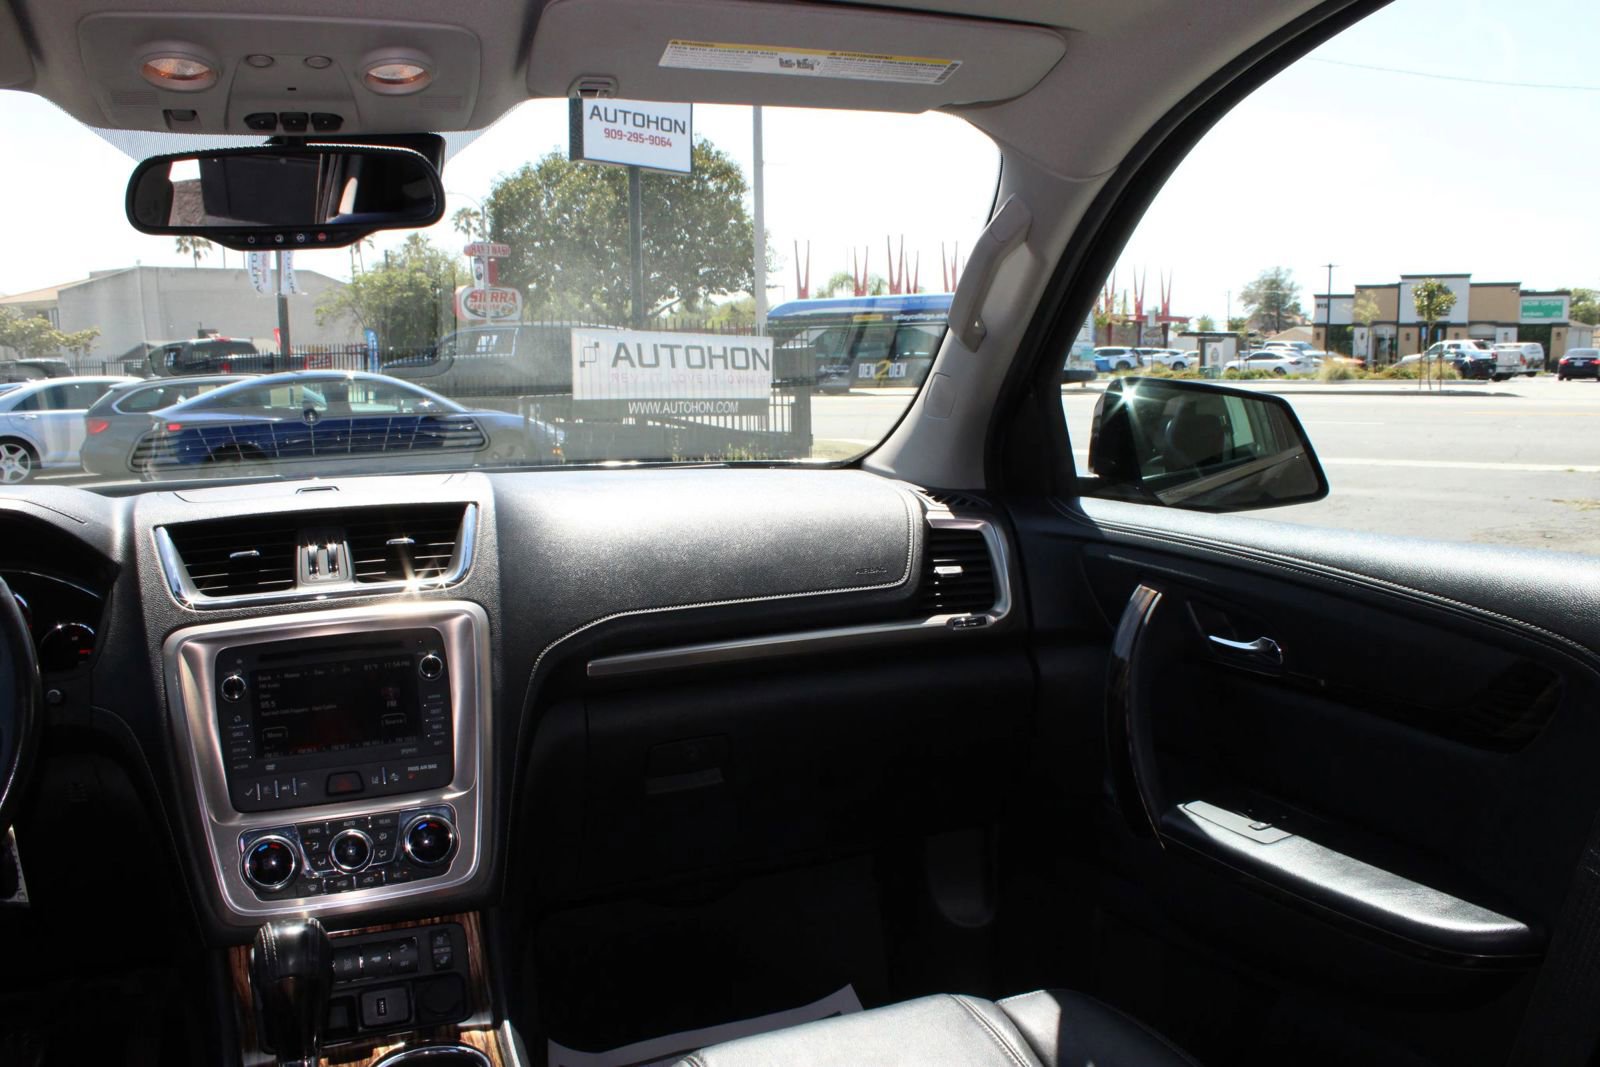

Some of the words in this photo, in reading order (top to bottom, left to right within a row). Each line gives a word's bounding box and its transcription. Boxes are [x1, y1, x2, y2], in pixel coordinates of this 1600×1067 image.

[589, 104, 685, 135] AUTOHON
[603, 127, 672, 148] 909-295-9064
[611, 342, 769, 371] AUTOHON
[628, 401, 738, 414] WWW.AUTOHON.COM
